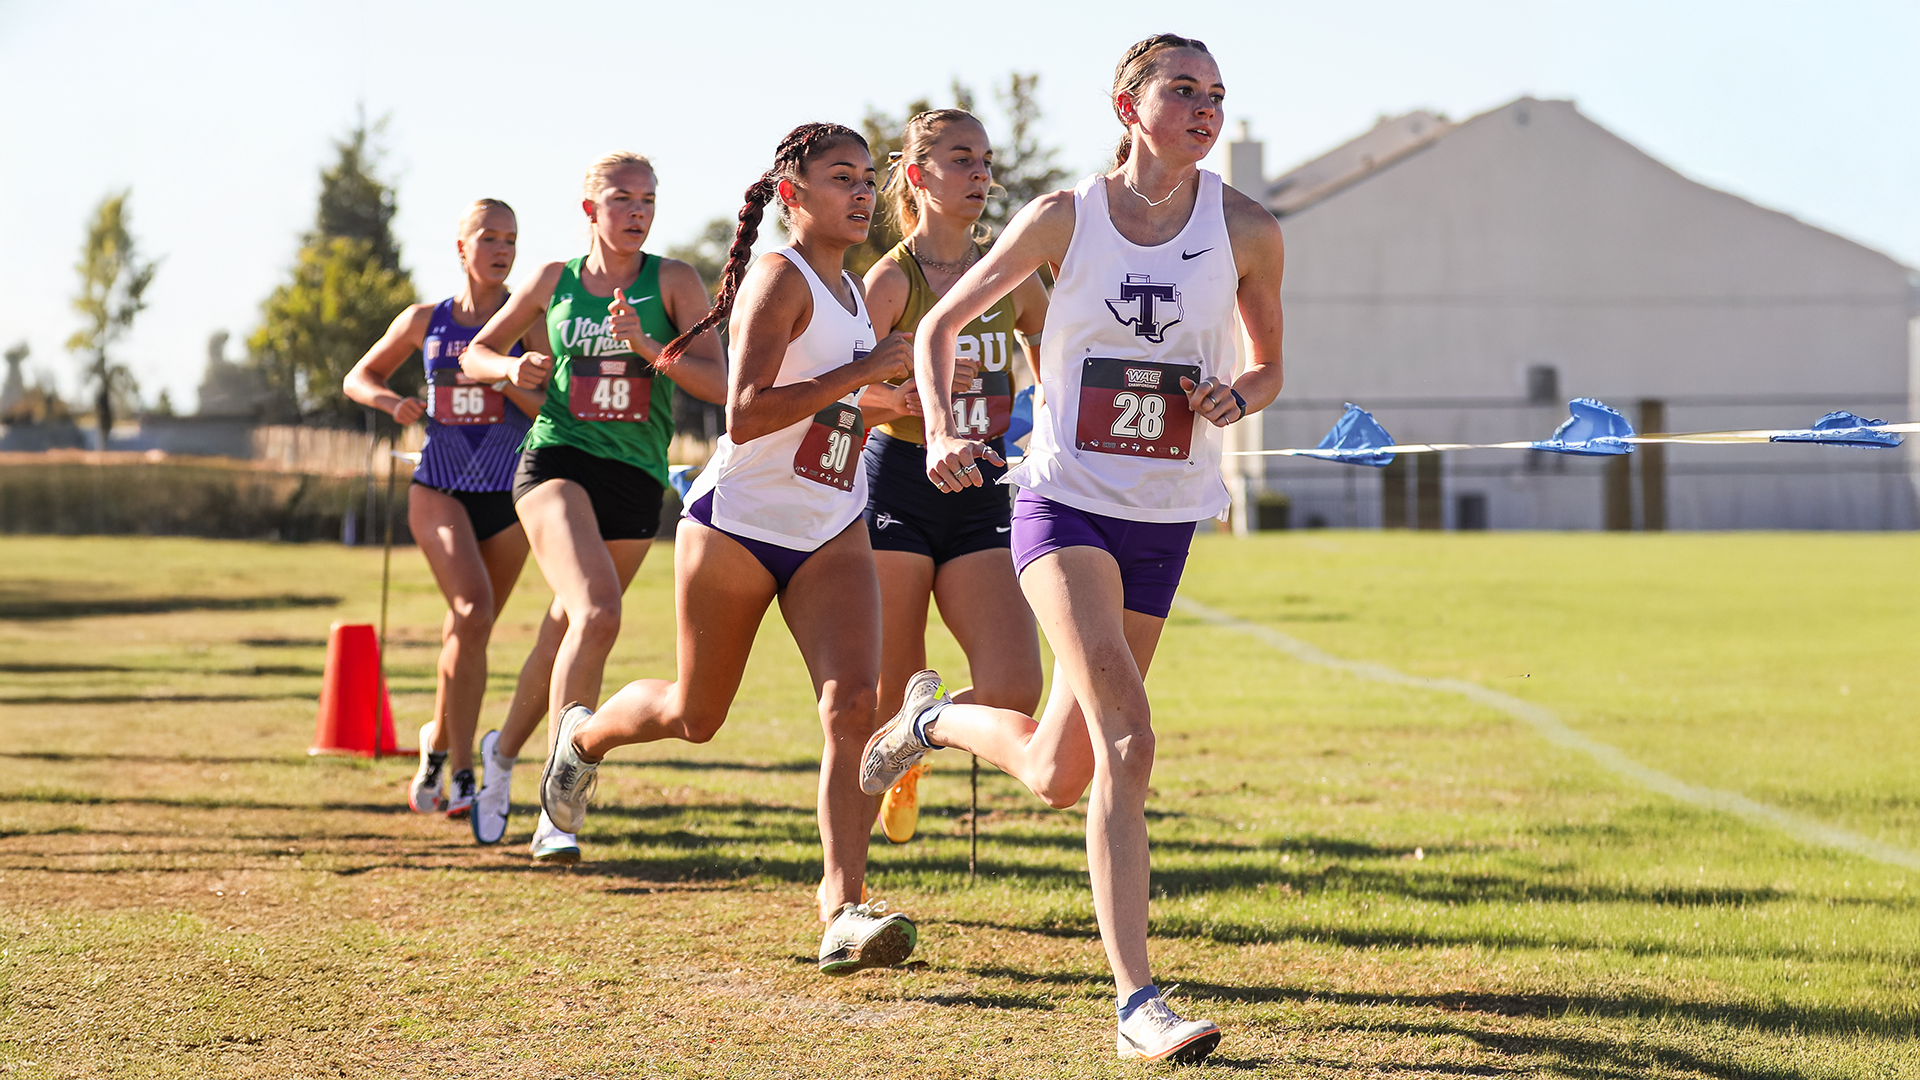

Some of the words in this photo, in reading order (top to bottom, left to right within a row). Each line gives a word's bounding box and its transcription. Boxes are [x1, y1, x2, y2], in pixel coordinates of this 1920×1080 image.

[1121, 282, 1176, 336] T
[955, 332, 1007, 372] BU
[591, 377, 630, 411] 48
[1126, 368, 1161, 384] WAC
[452, 387, 485, 415] 56
[952, 397, 990, 435] 14
[1111, 391, 1166, 440] 28
[819, 430, 852, 473] 30
